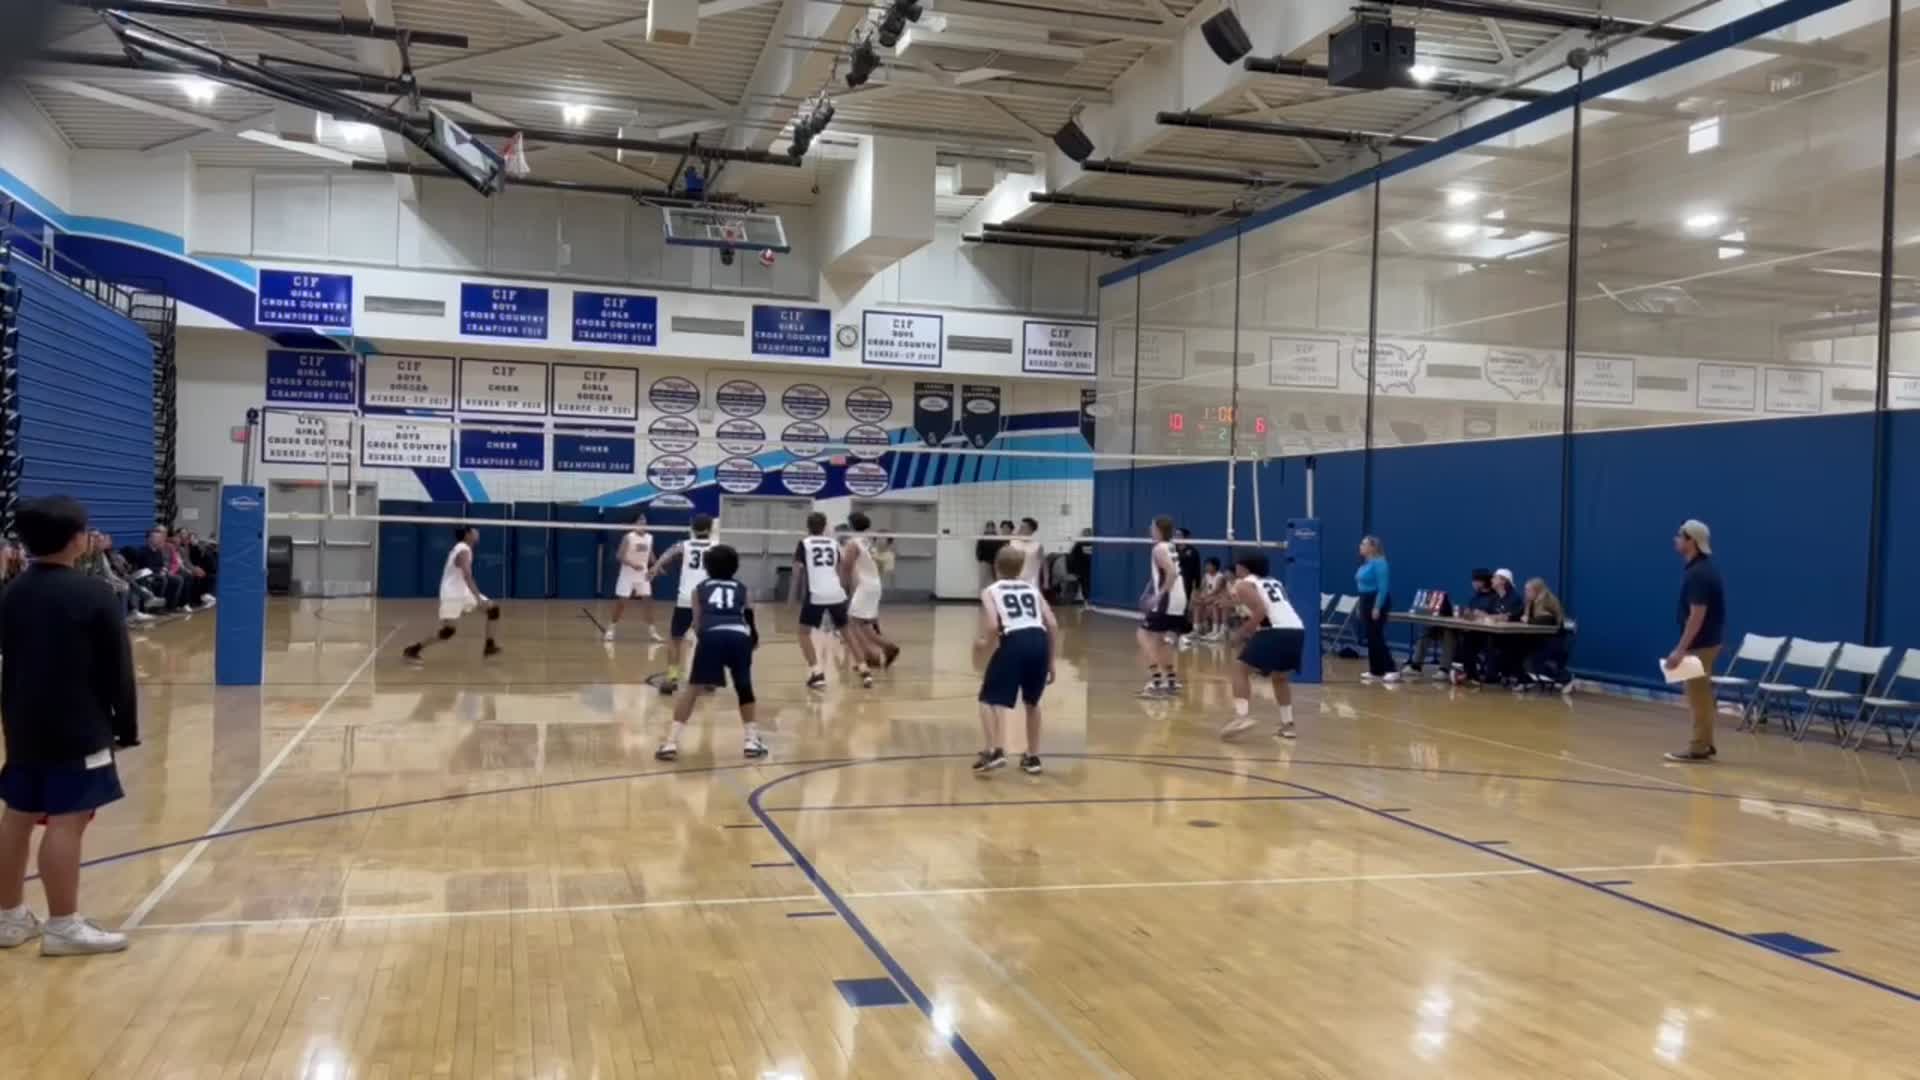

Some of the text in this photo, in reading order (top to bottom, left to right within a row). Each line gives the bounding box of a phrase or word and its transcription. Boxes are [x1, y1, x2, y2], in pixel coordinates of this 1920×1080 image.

[293, 276, 319, 287] CIF
[290, 290, 321, 298] GIRLS
[492, 289, 517, 301] CIF
[262, 298, 348, 310] CROSS COUNTRY
[492, 303, 517, 312] BOYS
[603, 297, 627, 308] CIF
[463, 311, 545, 322] CROSS COUNTRY
[601, 310, 629, 319] GIRLS
[780, 311, 802, 321] CIF
[575, 319, 655, 330] CROSS COUNTRY
[892, 319, 913, 329] CIF
[755, 331, 828, 342] CROSS COUNTRY
[1050, 328, 1072, 338] CIF
[868, 338, 937, 349] CROSS COUNTRY
[1028, 348, 1093, 359] CROSS COUNTRY
[299, 355, 325, 367] CIF
[397, 360, 422, 371] CIF
[297, 368, 327, 377] GIRLS
[492, 366, 516, 376] CIF
[583, 371, 607, 382] CIF
[269, 377, 354, 388] CROSS COUNTRY
[397, 374, 422, 382] BOYS
[581, 383, 609, 392] GIRLS
[267, 437, 301, 445] CROSS
[396, 432, 421, 440] BOYS
[367, 441, 448, 451] CROSS COUNTRY
[486, 441, 518, 449] CHEER
[812, 546, 835, 567] 23
[708, 586, 735, 609] 41
[1003, 592, 1037, 619] 99
